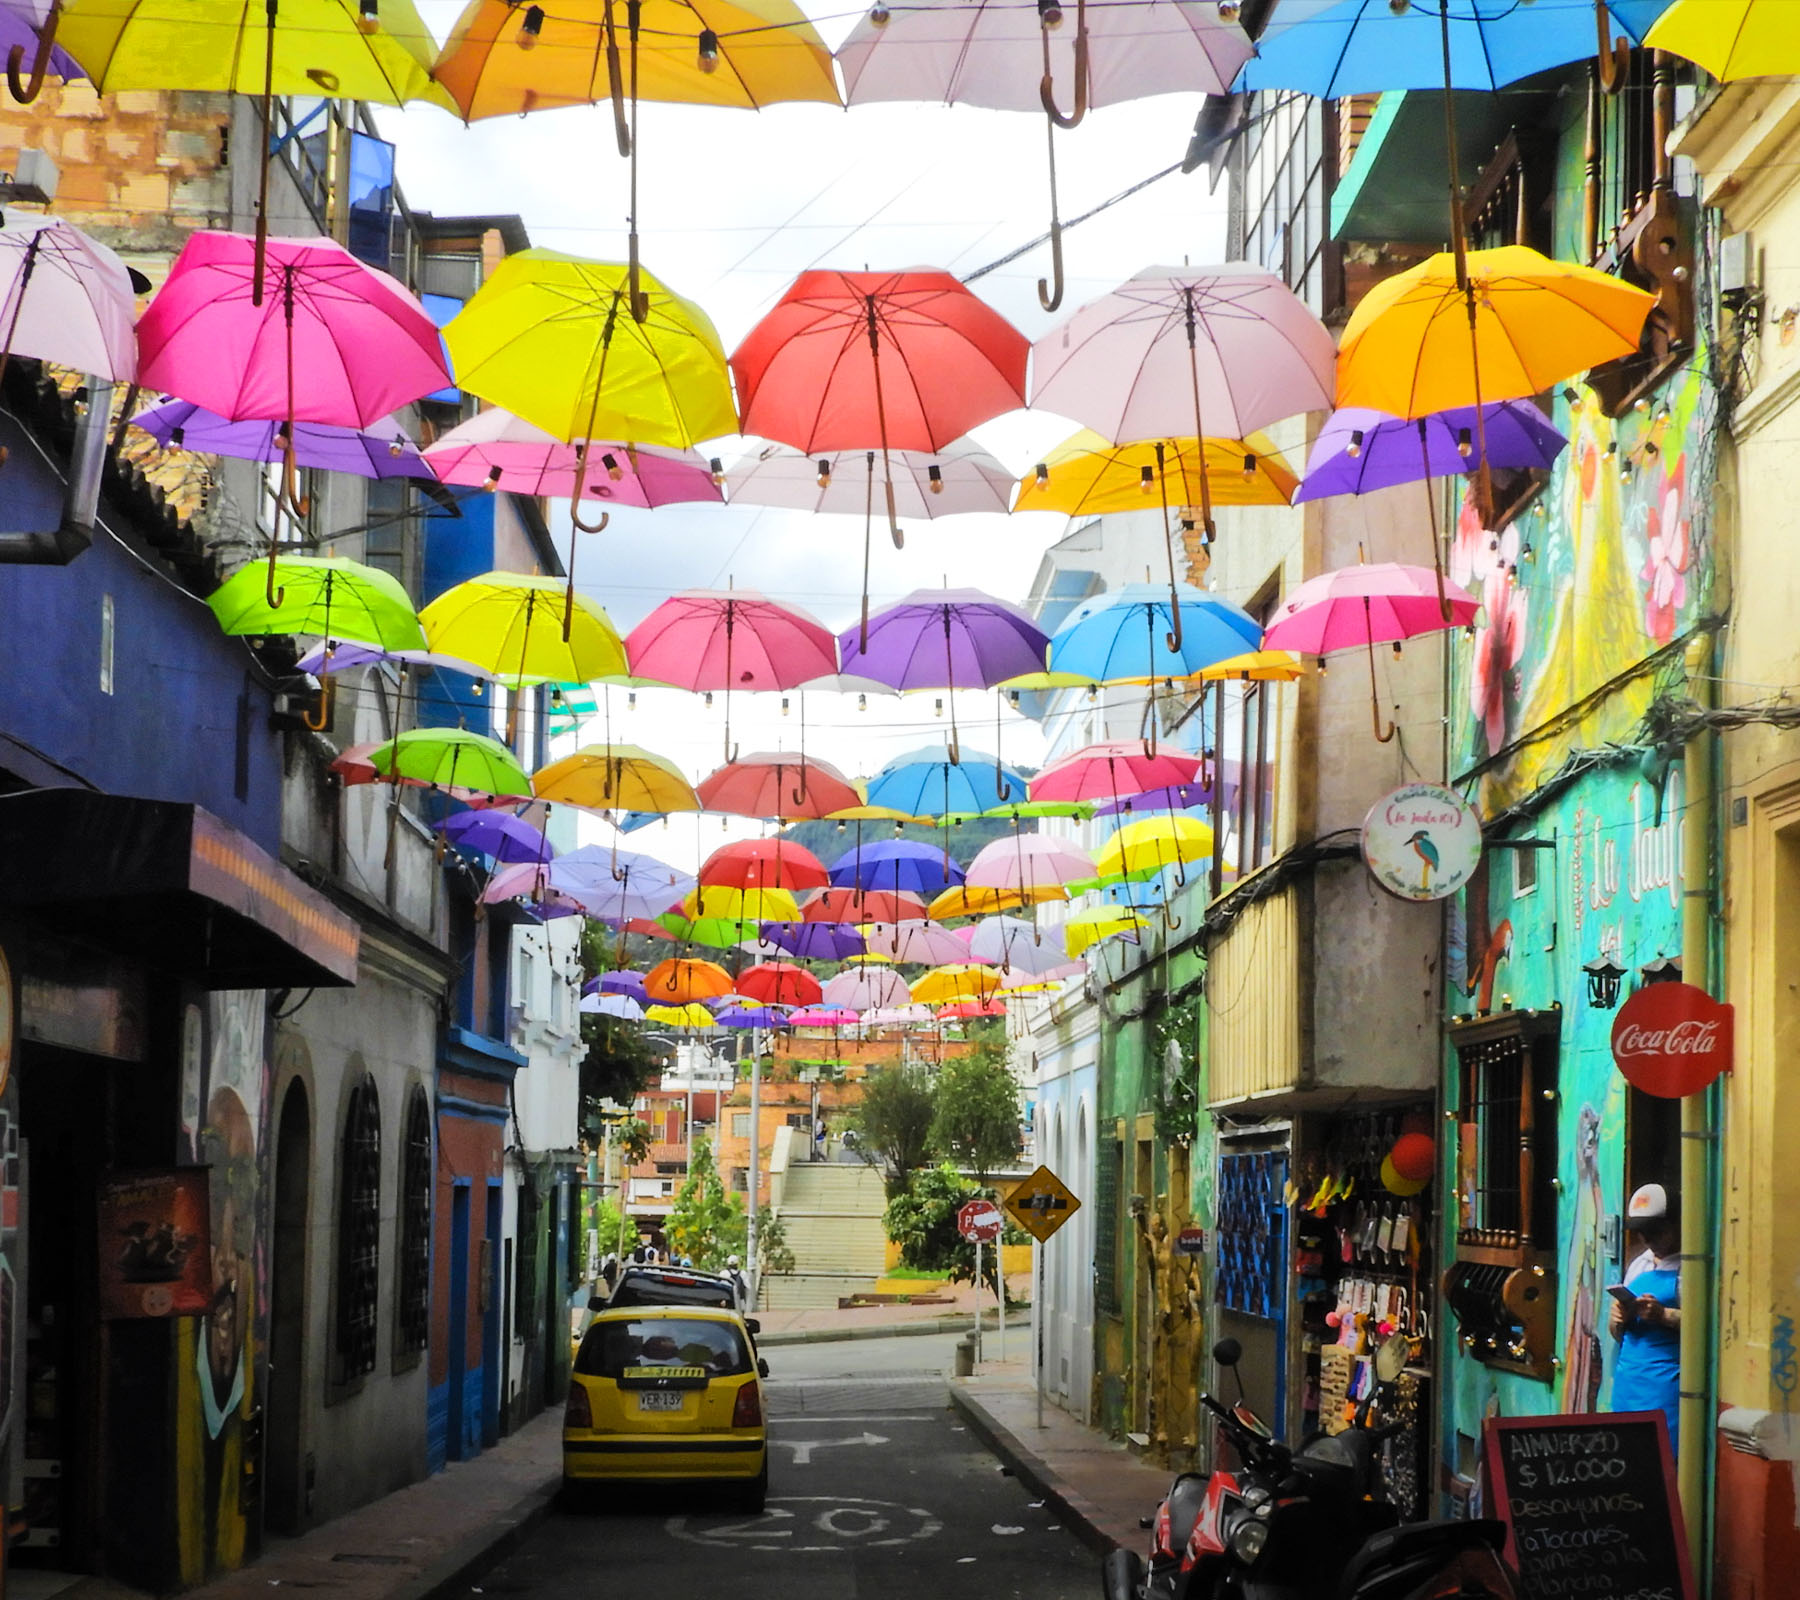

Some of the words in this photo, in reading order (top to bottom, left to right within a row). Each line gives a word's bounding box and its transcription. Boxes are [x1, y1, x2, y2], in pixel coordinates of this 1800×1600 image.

[1615, 1020, 1721, 1057] Coca-Cola
[1519, 1464, 1538, 1489] $
[1546, 1458, 1627, 1487] 12.000
